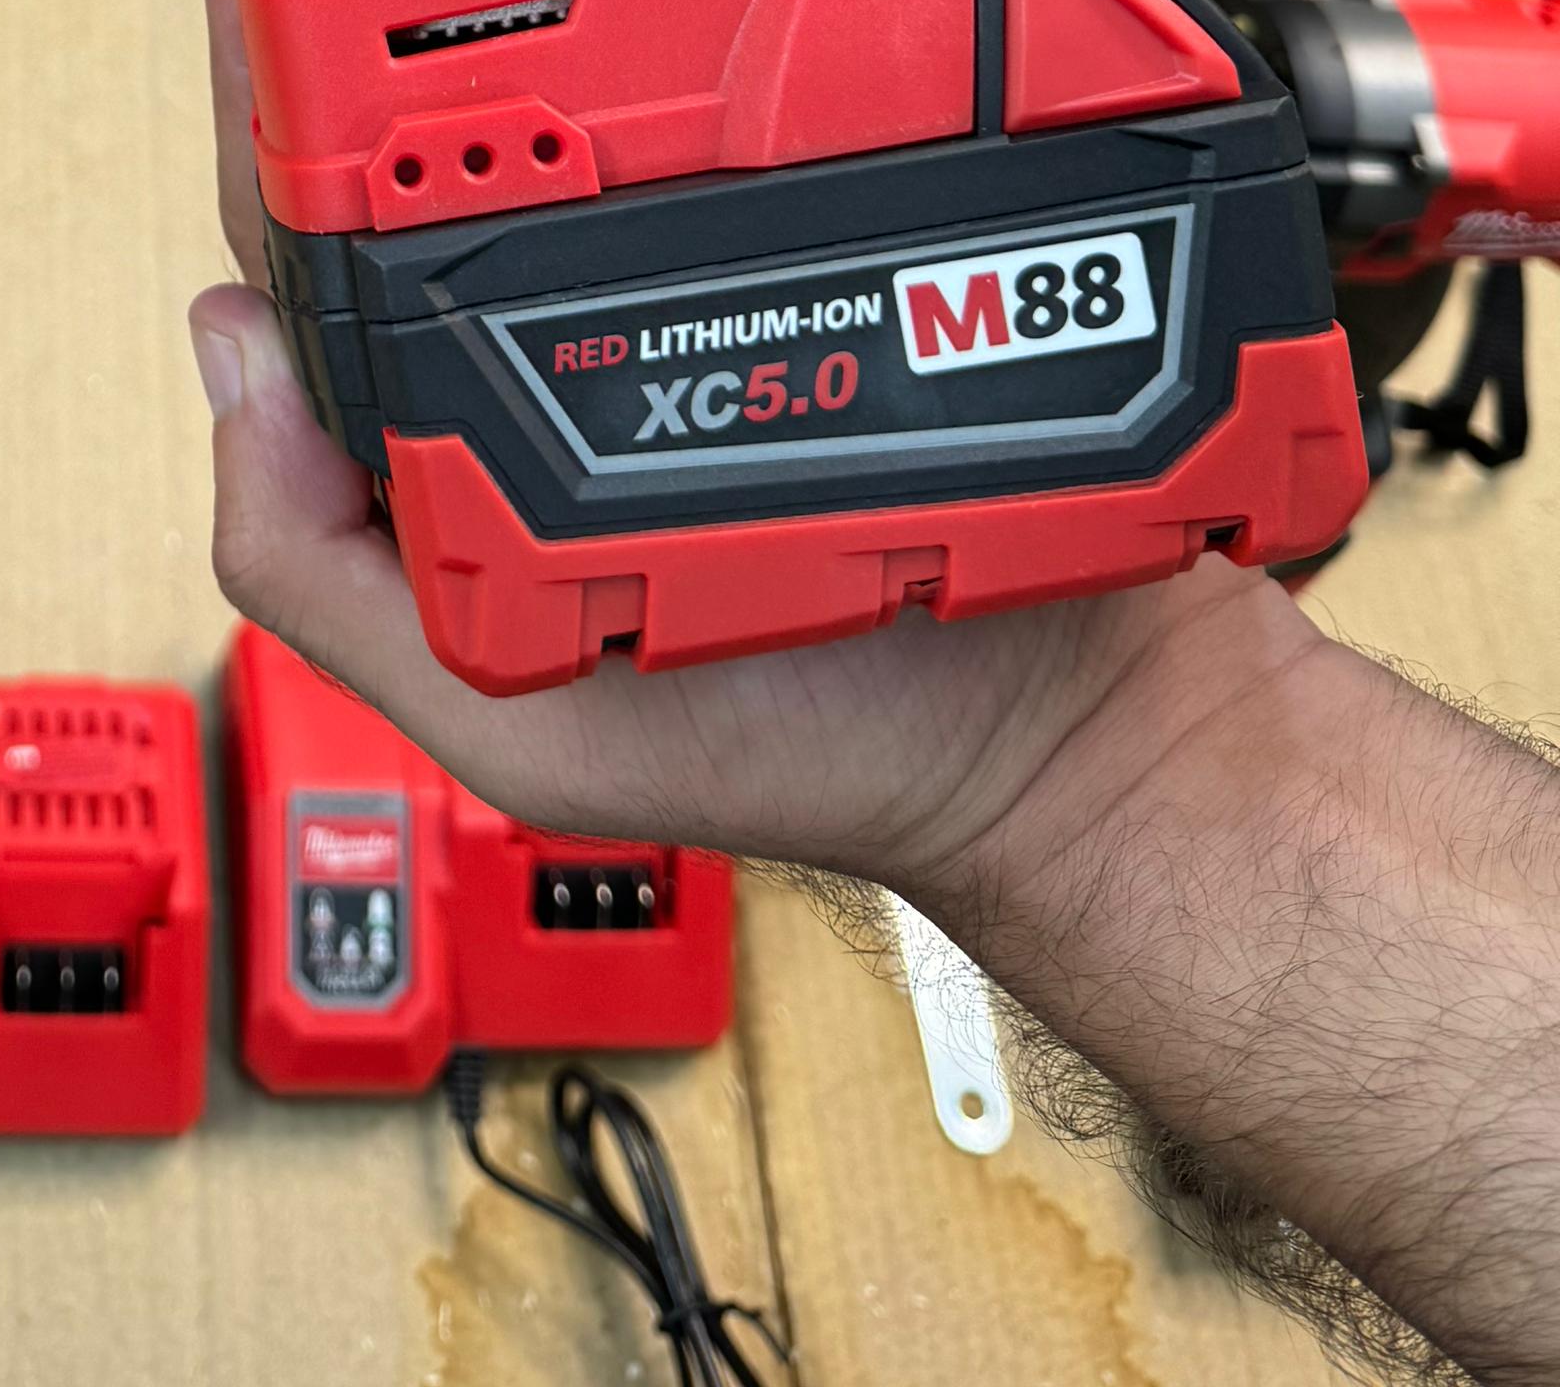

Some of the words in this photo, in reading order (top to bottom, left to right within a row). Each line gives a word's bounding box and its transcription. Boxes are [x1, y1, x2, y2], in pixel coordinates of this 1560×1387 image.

[552, 334, 629, 373] RED
[639, 293, 881, 362] LITHIUM-ION
[905, 252, 1125, 358] M88
[634, 351, 859, 441] XC5.0
